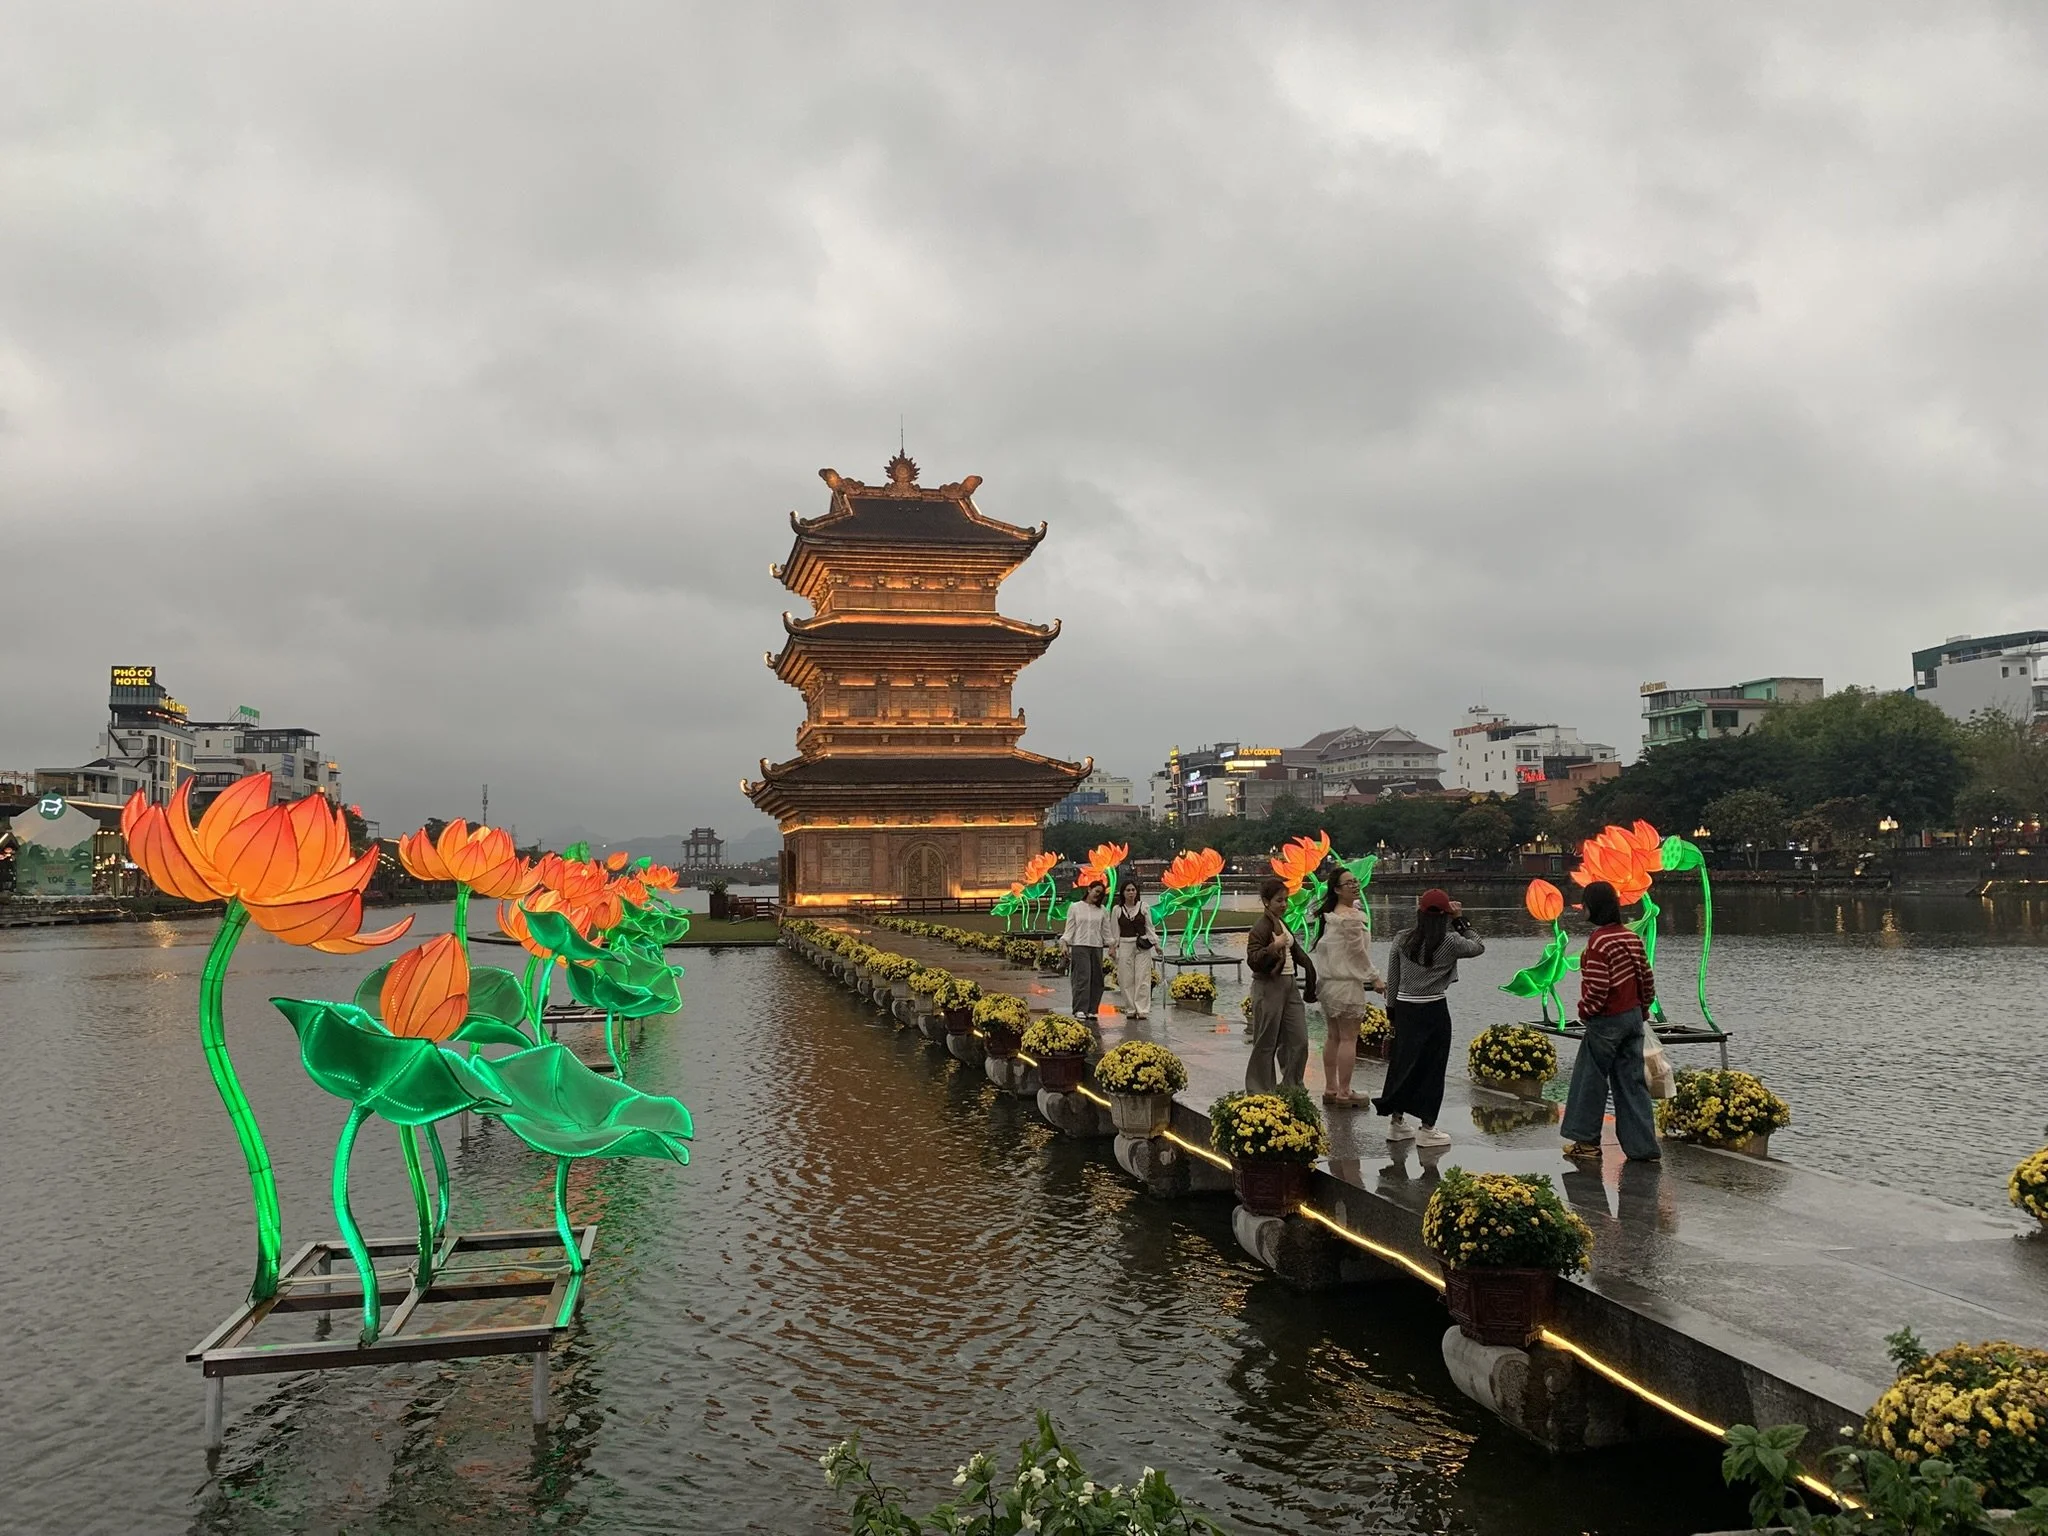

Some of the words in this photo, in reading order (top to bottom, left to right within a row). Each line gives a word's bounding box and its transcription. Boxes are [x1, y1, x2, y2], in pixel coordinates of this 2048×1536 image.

[113, 666, 136, 677] PHỐ
[115, 677, 150, 686] HOTEL
[1254, 748, 1282, 756] COCKTAIL
